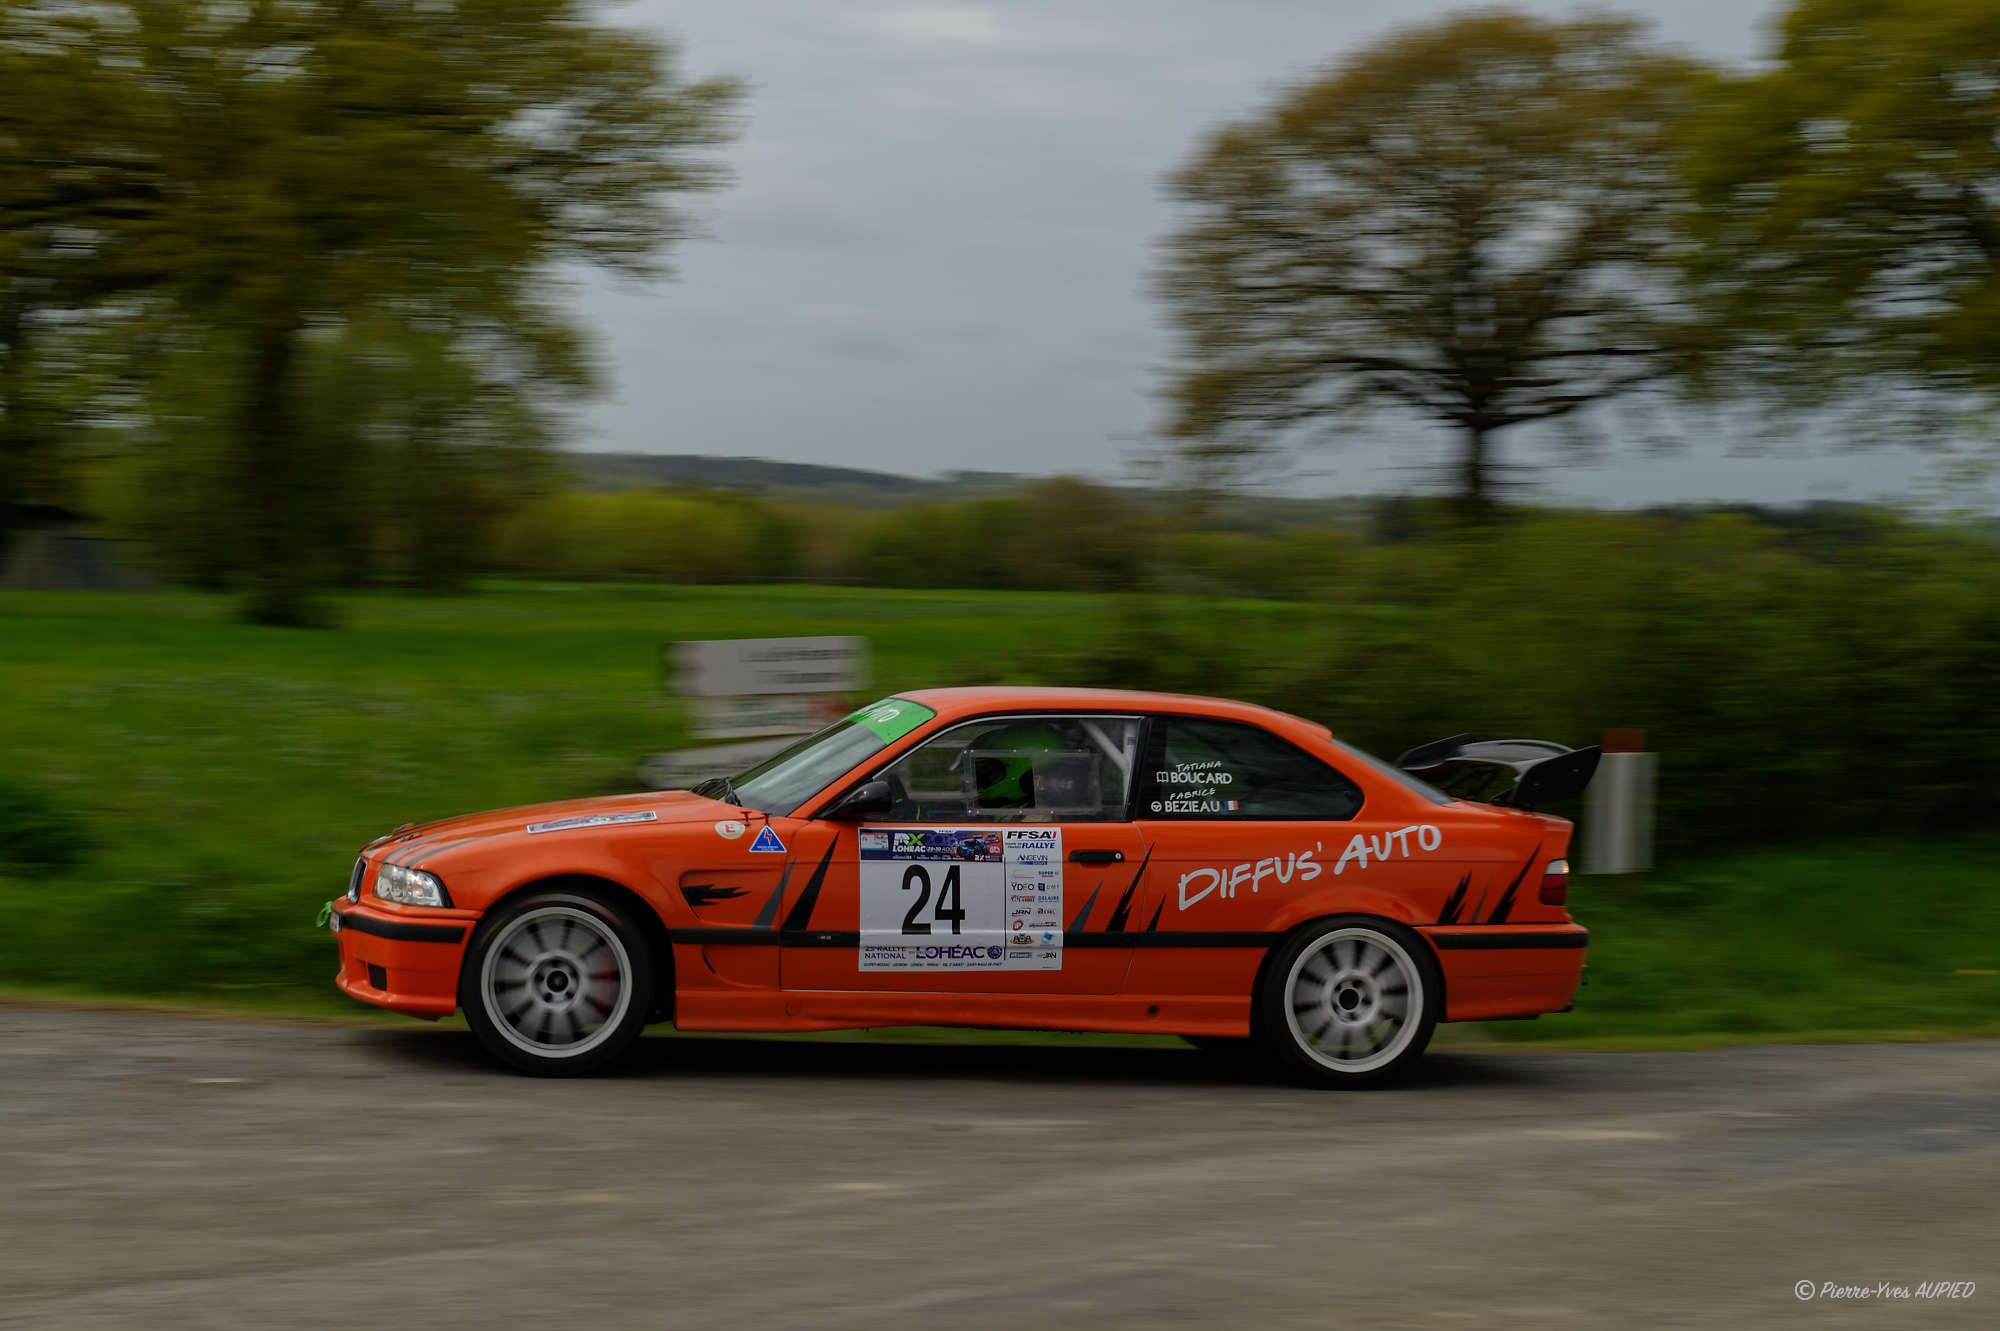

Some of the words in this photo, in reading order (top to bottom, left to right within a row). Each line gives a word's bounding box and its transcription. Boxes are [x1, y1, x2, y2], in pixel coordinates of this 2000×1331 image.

[1175, 760, 1223, 772] TATIANA
[1170, 771, 1233, 785] BOUCARD
[1169, 787, 1216, 800] FABRICE
[1164, 800, 1220, 813] BEZIEAU
[1007, 831, 1052, 839] FFSA
[1177, 842, 1323, 911] DIFFUS'
[1333, 824, 1442, 875] AUTO
[902, 864, 965, 935] 24
[864, 952, 906, 960] NATIONAL
[916, 944, 985, 959] LOHÉAC
